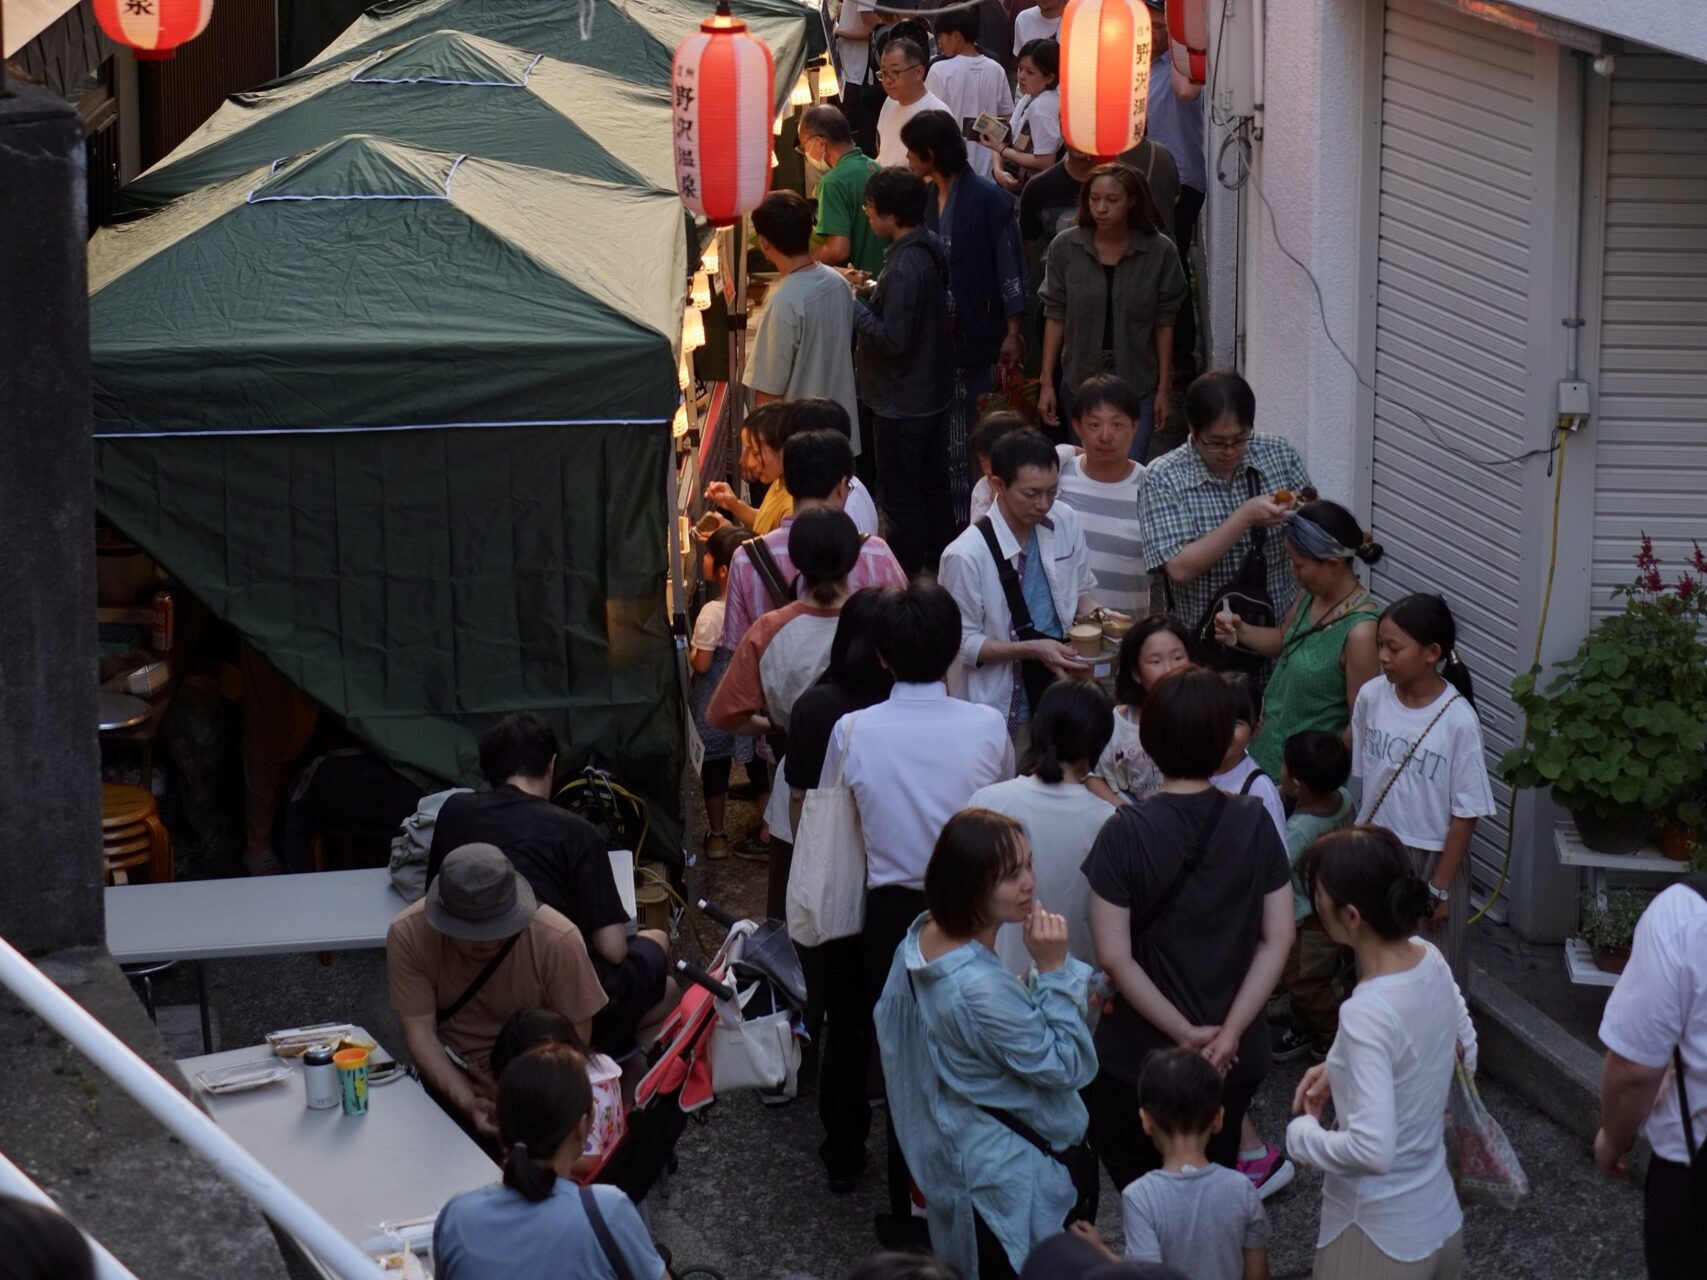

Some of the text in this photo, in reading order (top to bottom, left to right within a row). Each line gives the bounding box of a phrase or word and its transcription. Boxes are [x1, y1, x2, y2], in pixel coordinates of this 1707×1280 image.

[675, 85, 699, 199] 野沢温泉
[1133, 41, 1151, 142] 野沢温泉
